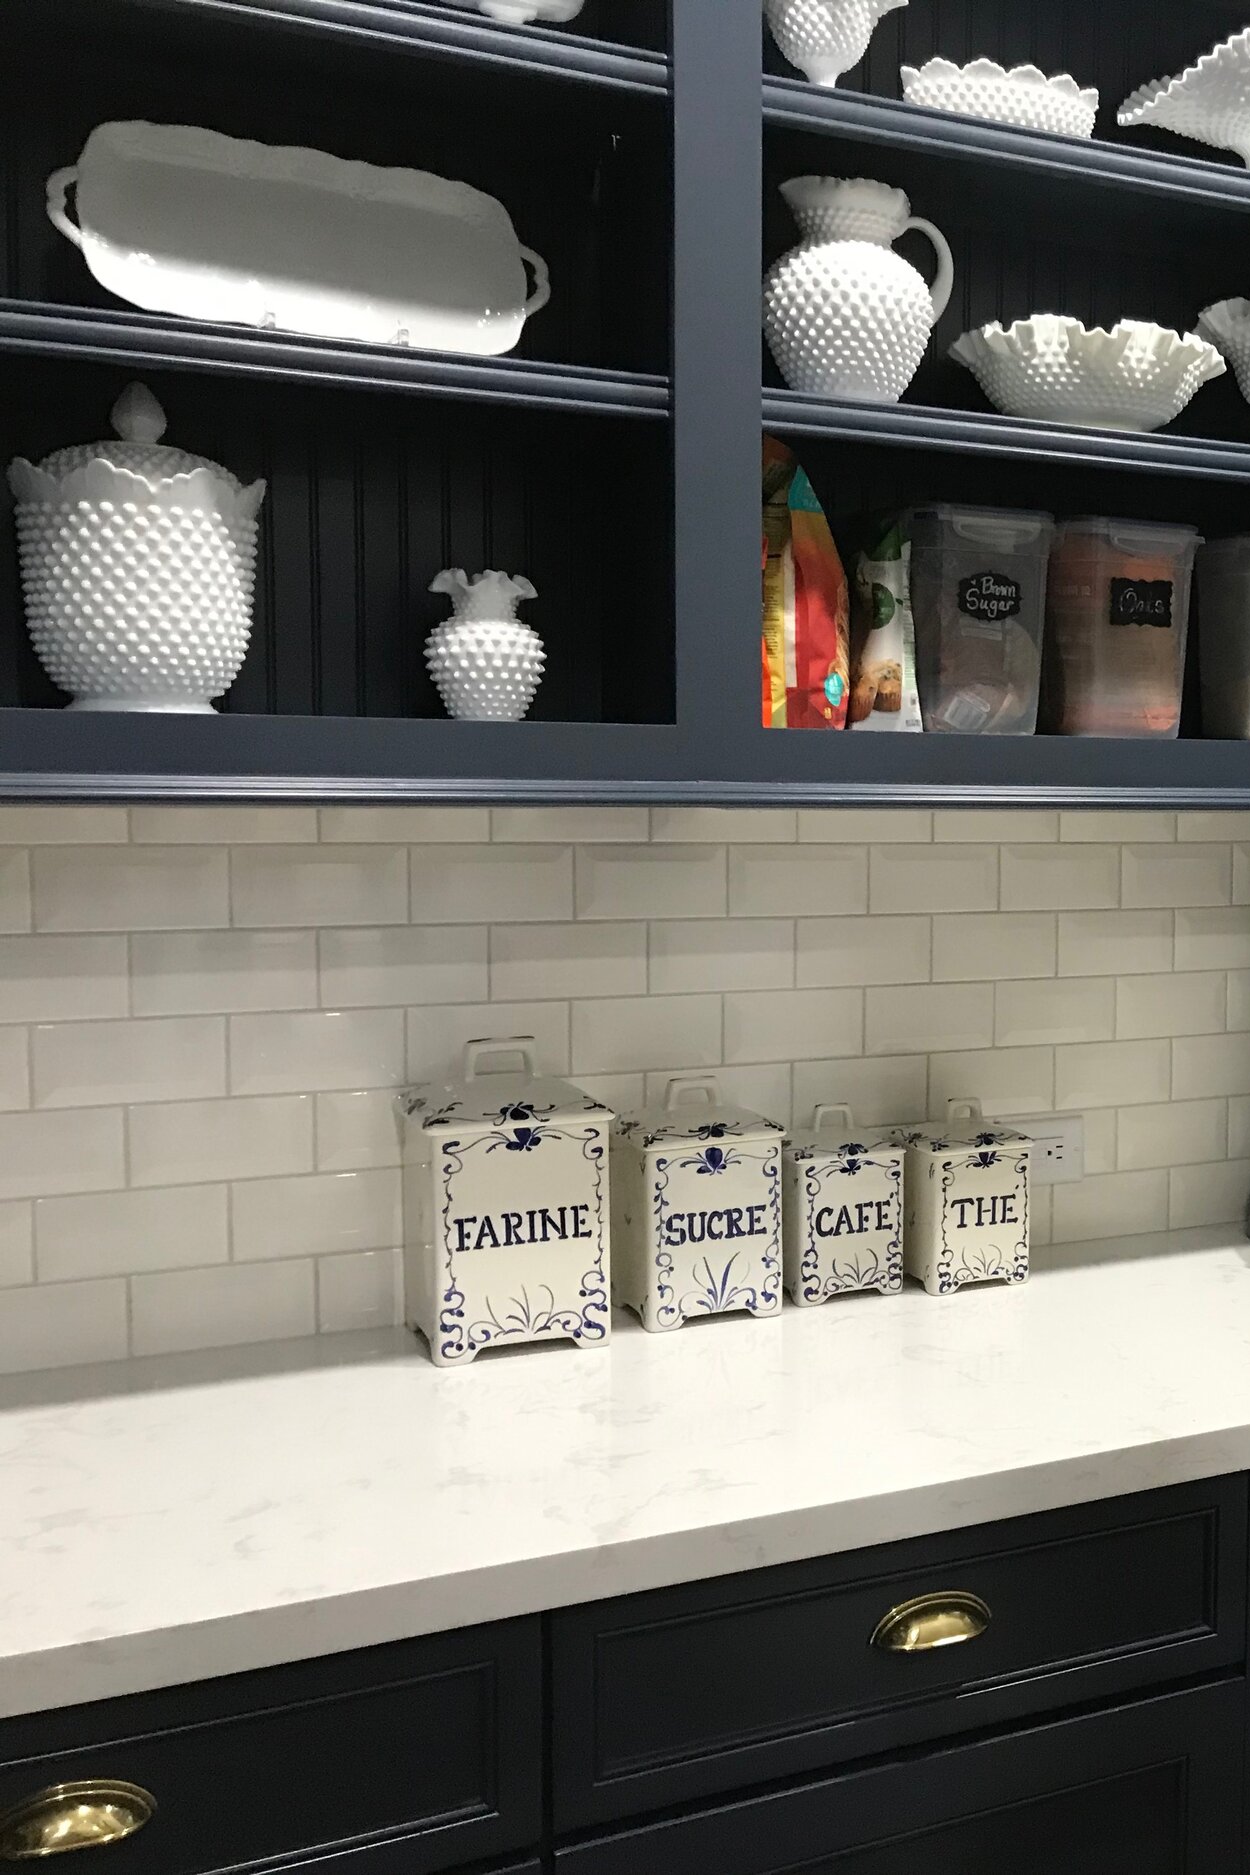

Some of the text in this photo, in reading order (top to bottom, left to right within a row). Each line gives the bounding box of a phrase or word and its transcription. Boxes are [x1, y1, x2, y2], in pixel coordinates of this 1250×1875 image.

[965, 587, 1015, 618] Sugar
[980, 575, 1016, 597] Brown
[453, 1203, 592, 1252] FARINE
[665, 1204, 768, 1246] SUCRE
[815, 1192, 896, 1238] CAFÉ
[950, 1184, 1019, 1229] THÉ
